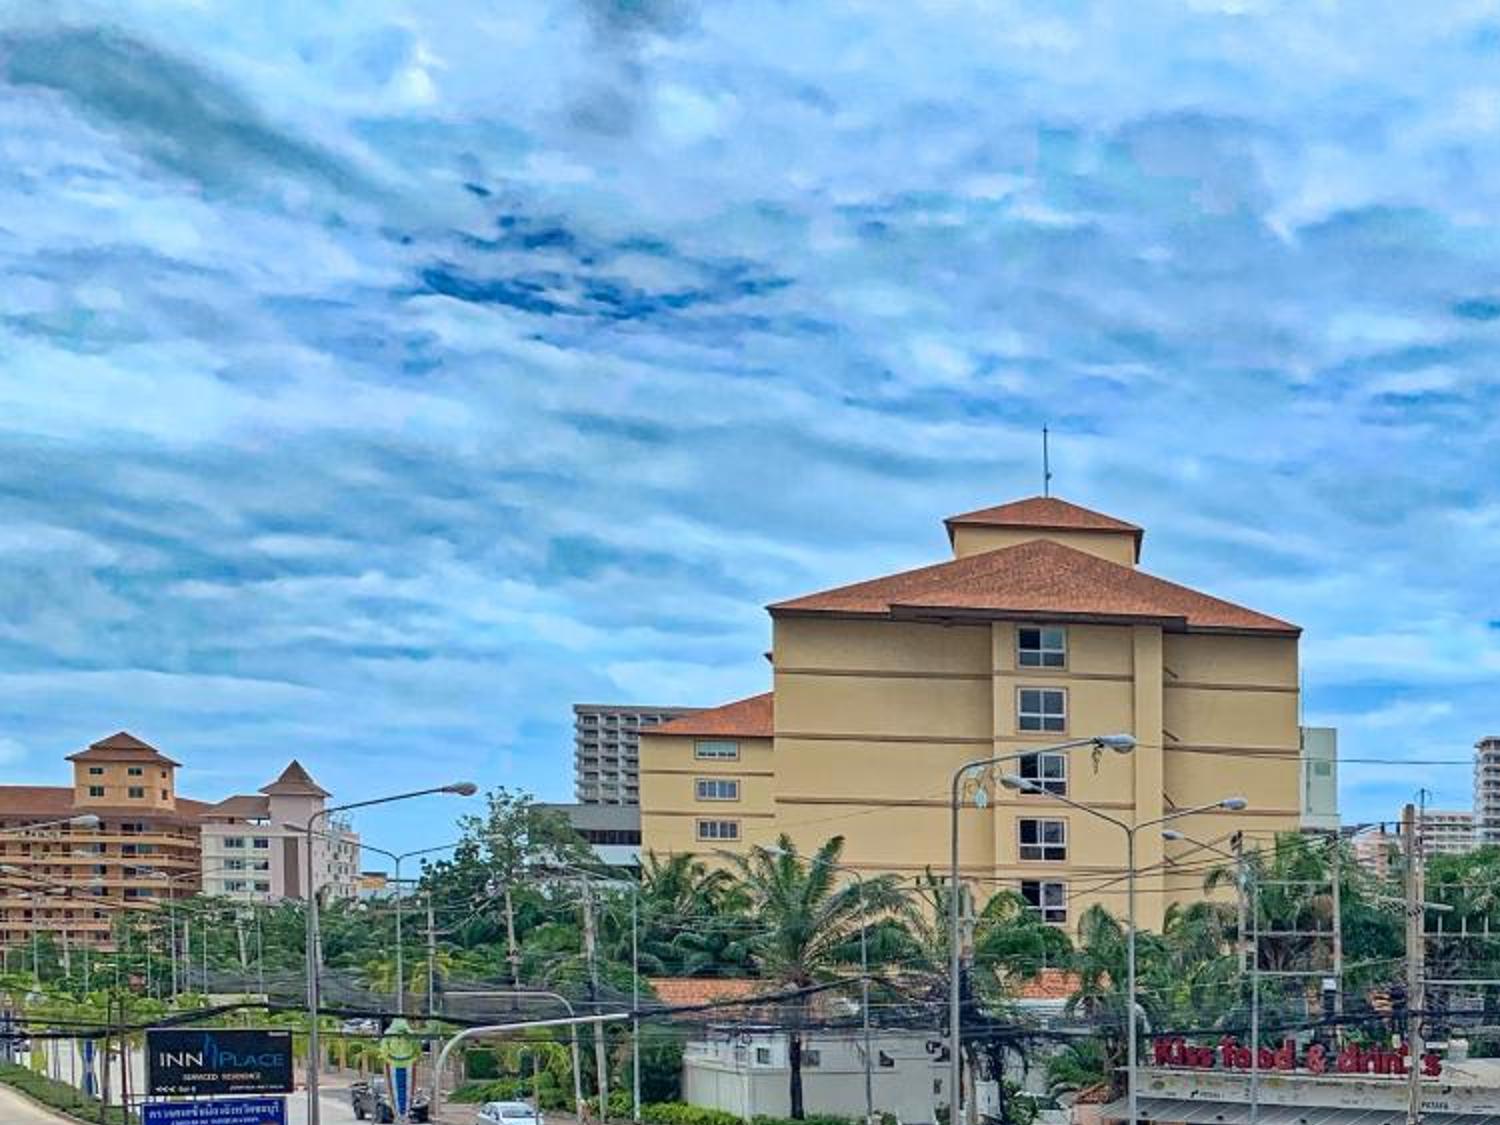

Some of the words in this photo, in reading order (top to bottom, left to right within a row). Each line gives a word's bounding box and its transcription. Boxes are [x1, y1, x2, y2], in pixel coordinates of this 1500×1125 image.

[159, 1052, 203, 1067] INN
[219, 1052, 283, 1067] PLACE
[1220, 1035, 1296, 1070] food
